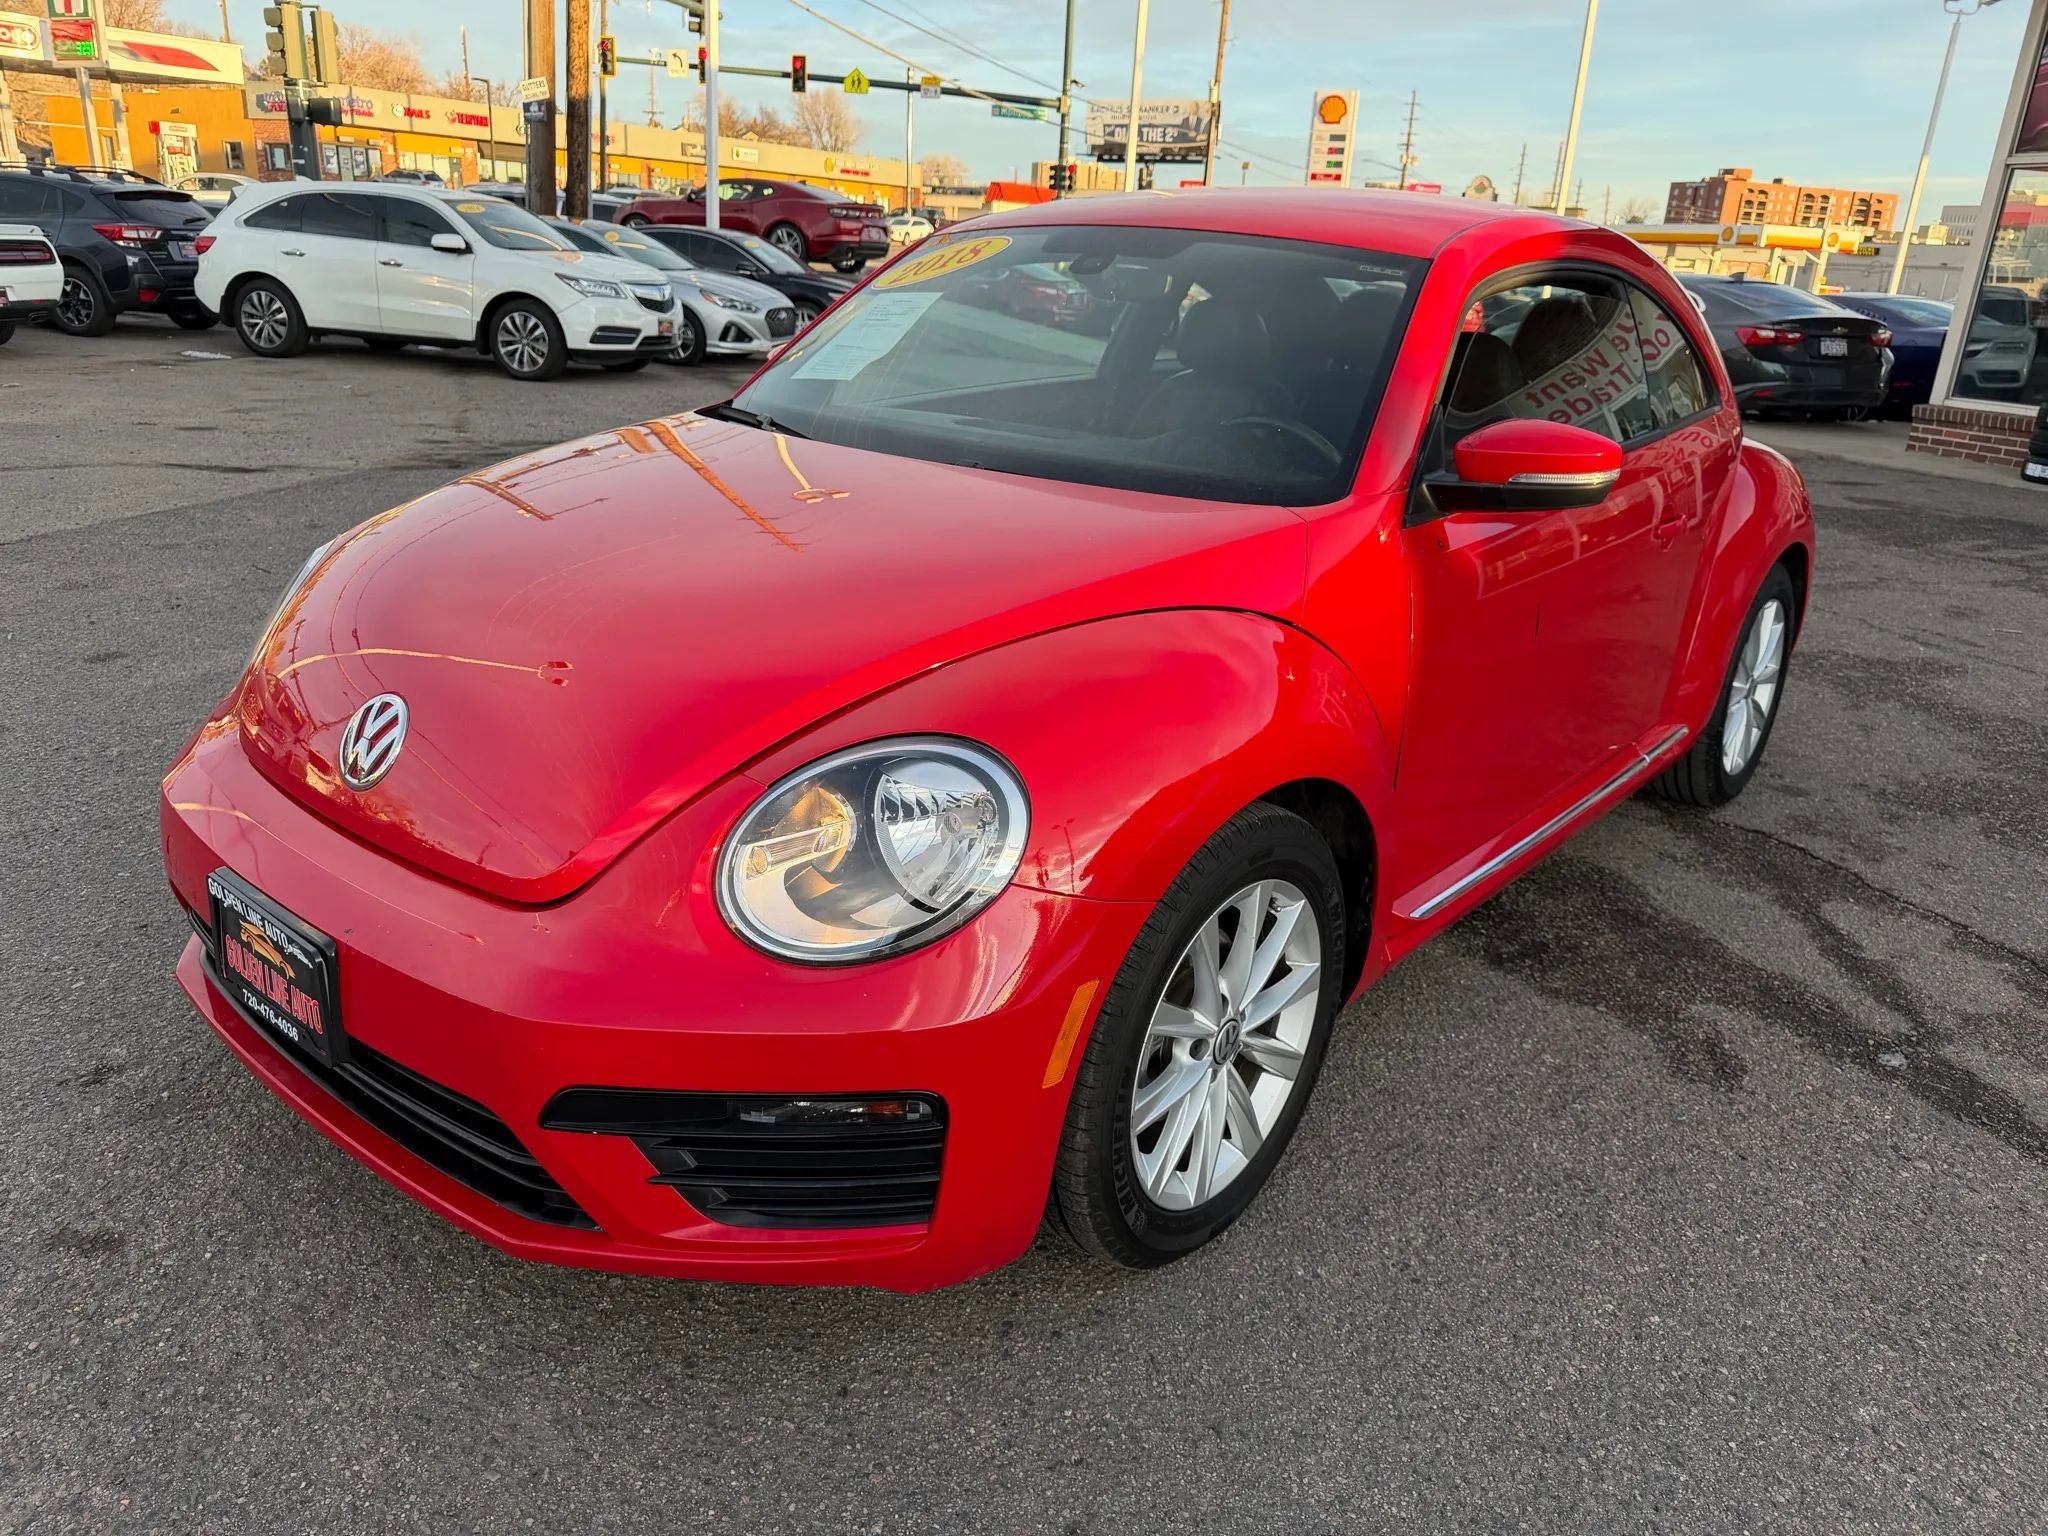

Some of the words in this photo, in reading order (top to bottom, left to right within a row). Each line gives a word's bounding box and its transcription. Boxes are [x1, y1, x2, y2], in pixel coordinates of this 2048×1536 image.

[888, 239, 993, 285] 2018
[207, 877, 243, 914] GOLDEN
[242, 902, 264, 928] LINE
[264, 919, 289, 949] AUTO
[225, 934, 265, 993] GOLDEN
[264, 965, 291, 1014] LINE
[290, 984, 324, 1035] AUTO
[242, 988, 299, 1042] 720-476-4036
